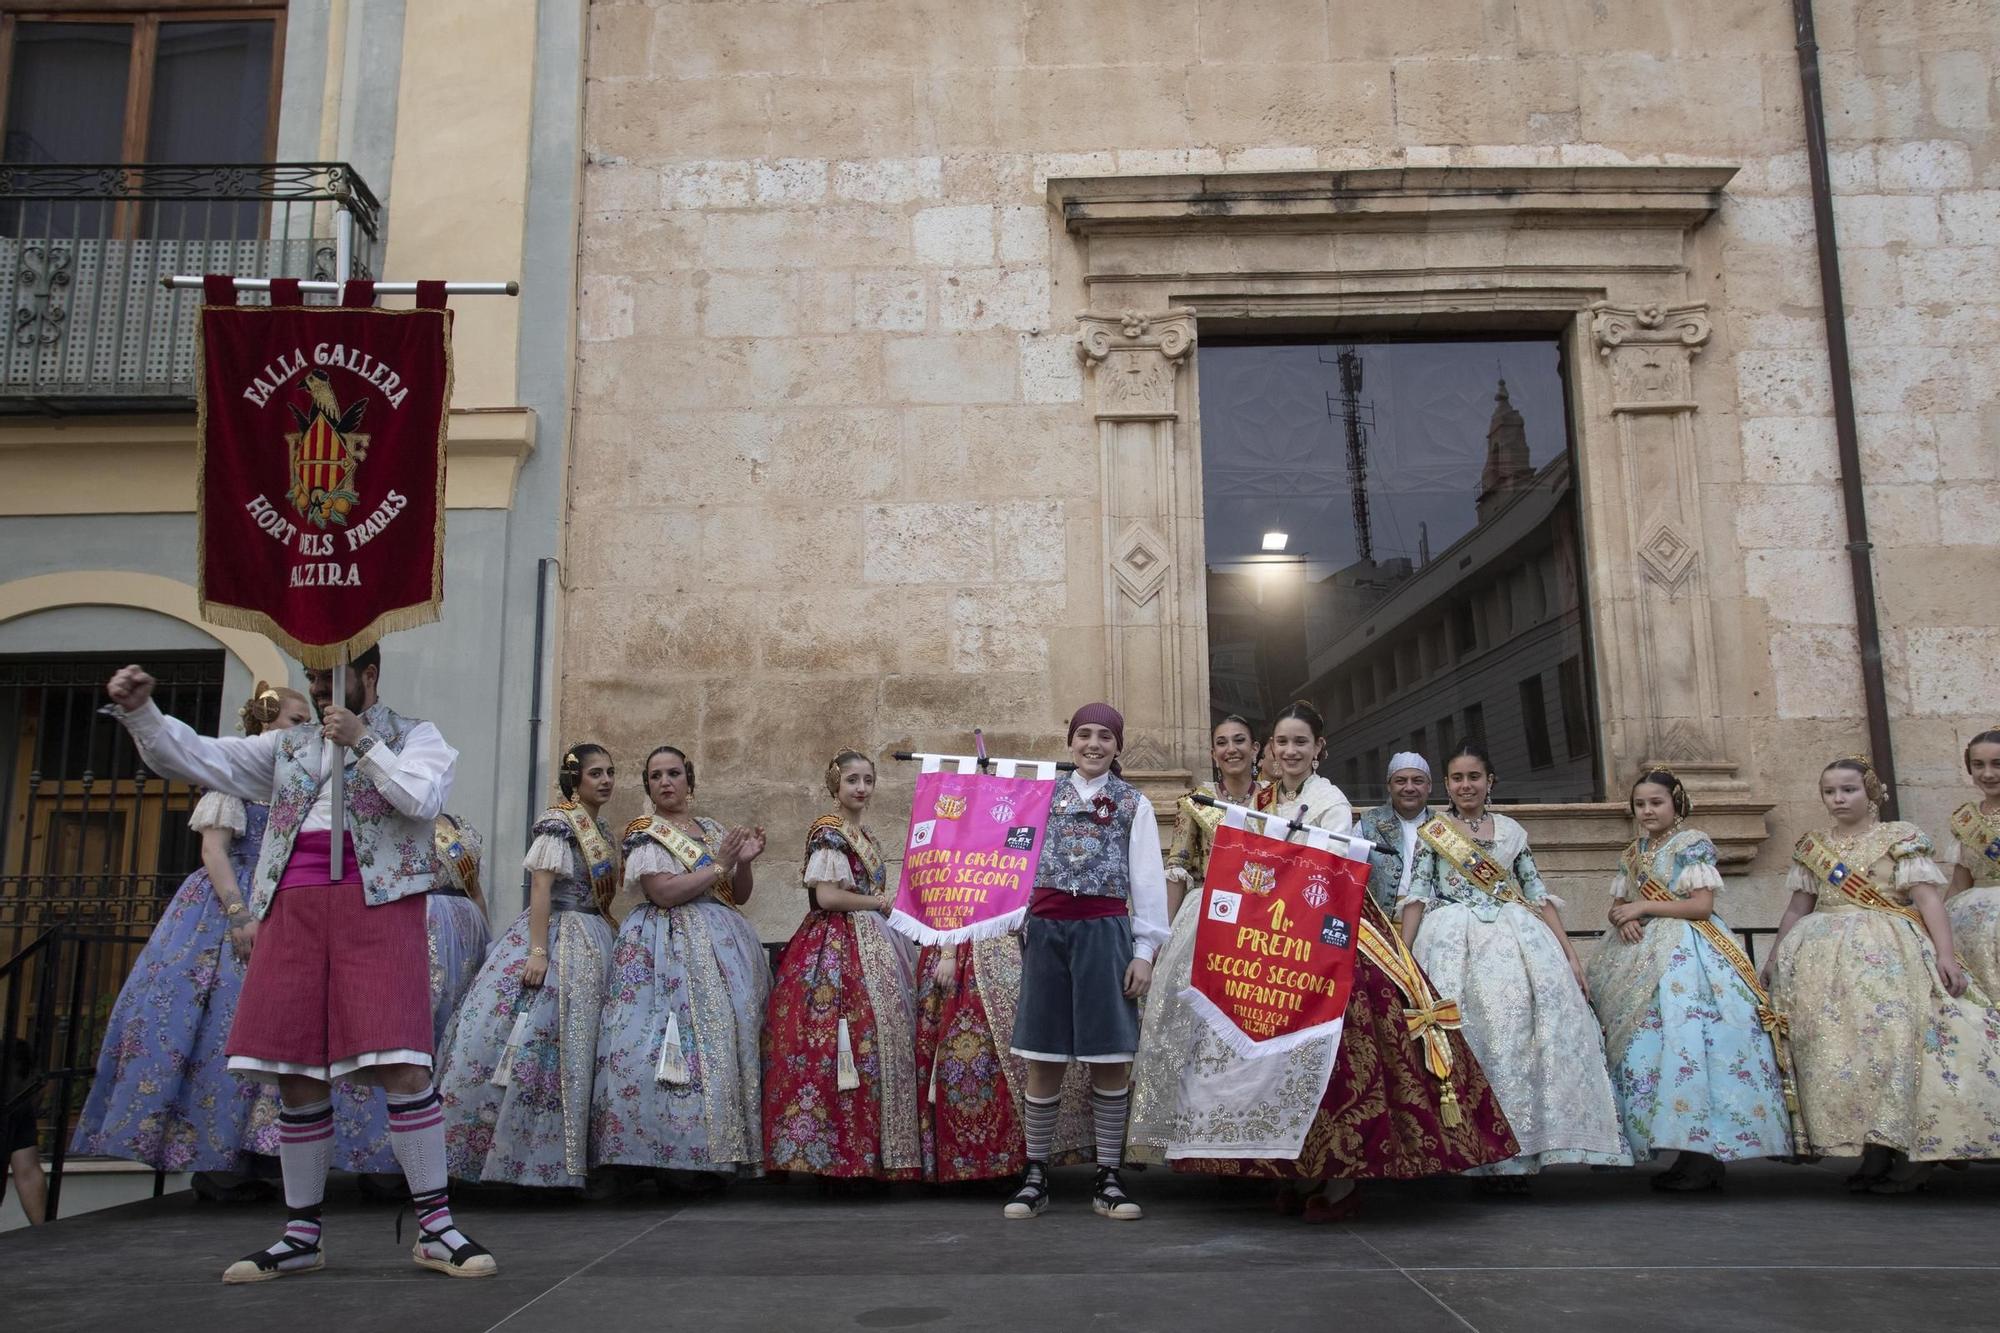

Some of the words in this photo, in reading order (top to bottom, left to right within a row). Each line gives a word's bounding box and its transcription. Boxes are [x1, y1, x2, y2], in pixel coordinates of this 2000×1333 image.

[243, 348, 306, 408] FALLA
[315, 343, 409, 409] GALLERA
[245, 494, 299, 545] HORT
[344, 489, 408, 551] FRARES
[289, 562, 361, 587] ALZIRA
[908, 850, 951, 869] INGENI
[954, 852, 961, 865] I
[964, 851, 1028, 871] GRÀCIA
[909, 863, 951, 889] SECCIÓ
[955, 868, 1020, 890] SEGONA
[921, 887, 989, 904] INFANTIL
[925, 906, 951, 917] FALLES
[953, 906, 974, 917] 2024
[932, 917, 963, 928] ALZIRA
[1266, 898, 1294, 932] 1r
[1236, 926, 1312, 962] PREMI
[1322, 928, 1349, 940] FLEX
[1206, 952, 1262, 978] SECCIÓ
[1266, 965, 1335, 997] SEGONA
[1225, 979, 1304, 1012] INFANTIL
[1233, 1004, 1263, 1020] FALLES
[1265, 1011, 1290, 1026] 2024
[1241, 1018, 1276, 1036] ALZIRA
